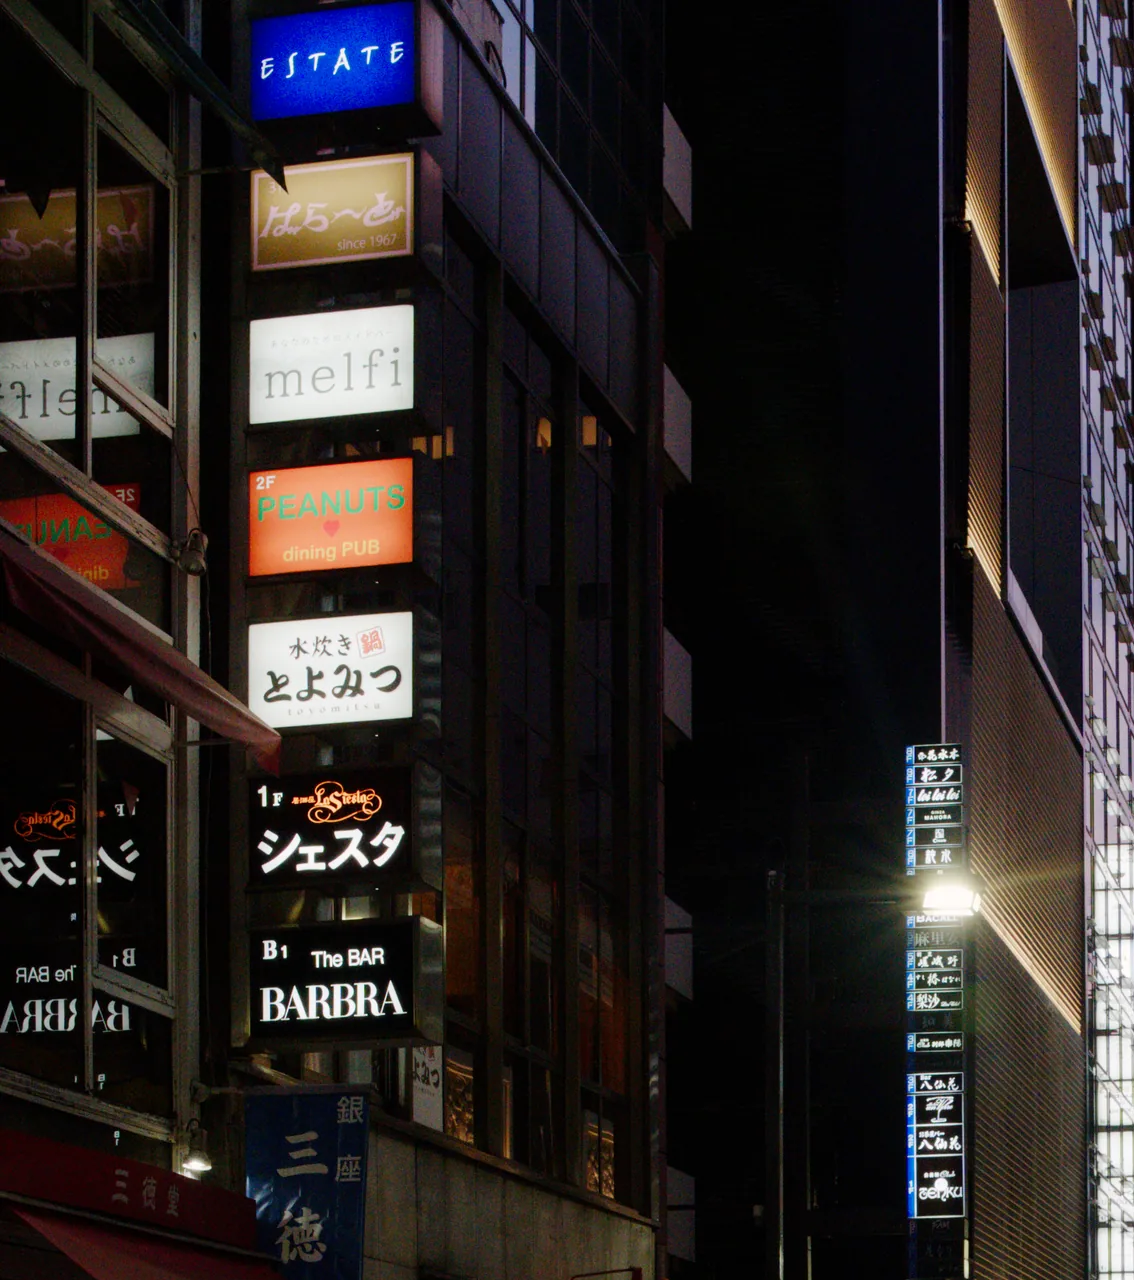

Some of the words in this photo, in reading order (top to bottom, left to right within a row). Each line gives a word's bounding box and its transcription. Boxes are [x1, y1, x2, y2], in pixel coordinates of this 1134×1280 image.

[261, 41, 404, 80] ESTATE
[337, 236, 366, 251] since
[369, 233, 397, 247] 1967
[264, 347, 402, 399] melfi
[256, 475, 276, 490] 2F
[257, 484, 405, 522] PEANUTS
[282, 545, 336, 572] dining
[342, 539, 380, 557] PUB
[289, 633, 352, 659] 水炊き
[361, 630, 382, 655] 鍋
[263, 664, 402, 703] とよみつ
[288, 703, 381, 716] toyomitsu
[257, 821, 405, 874] シェスタ
[263, 940, 288, 960] B1
[311, 951, 343, 968] The
[347, 947, 384, 967] BAR
[260, 979, 407, 1022] BARBRA
[335, 1095, 364, 1183] 銀座
[918, 1137, 962, 1150] 八仙花
[111, 1169, 180, 1218] 三徳堂
